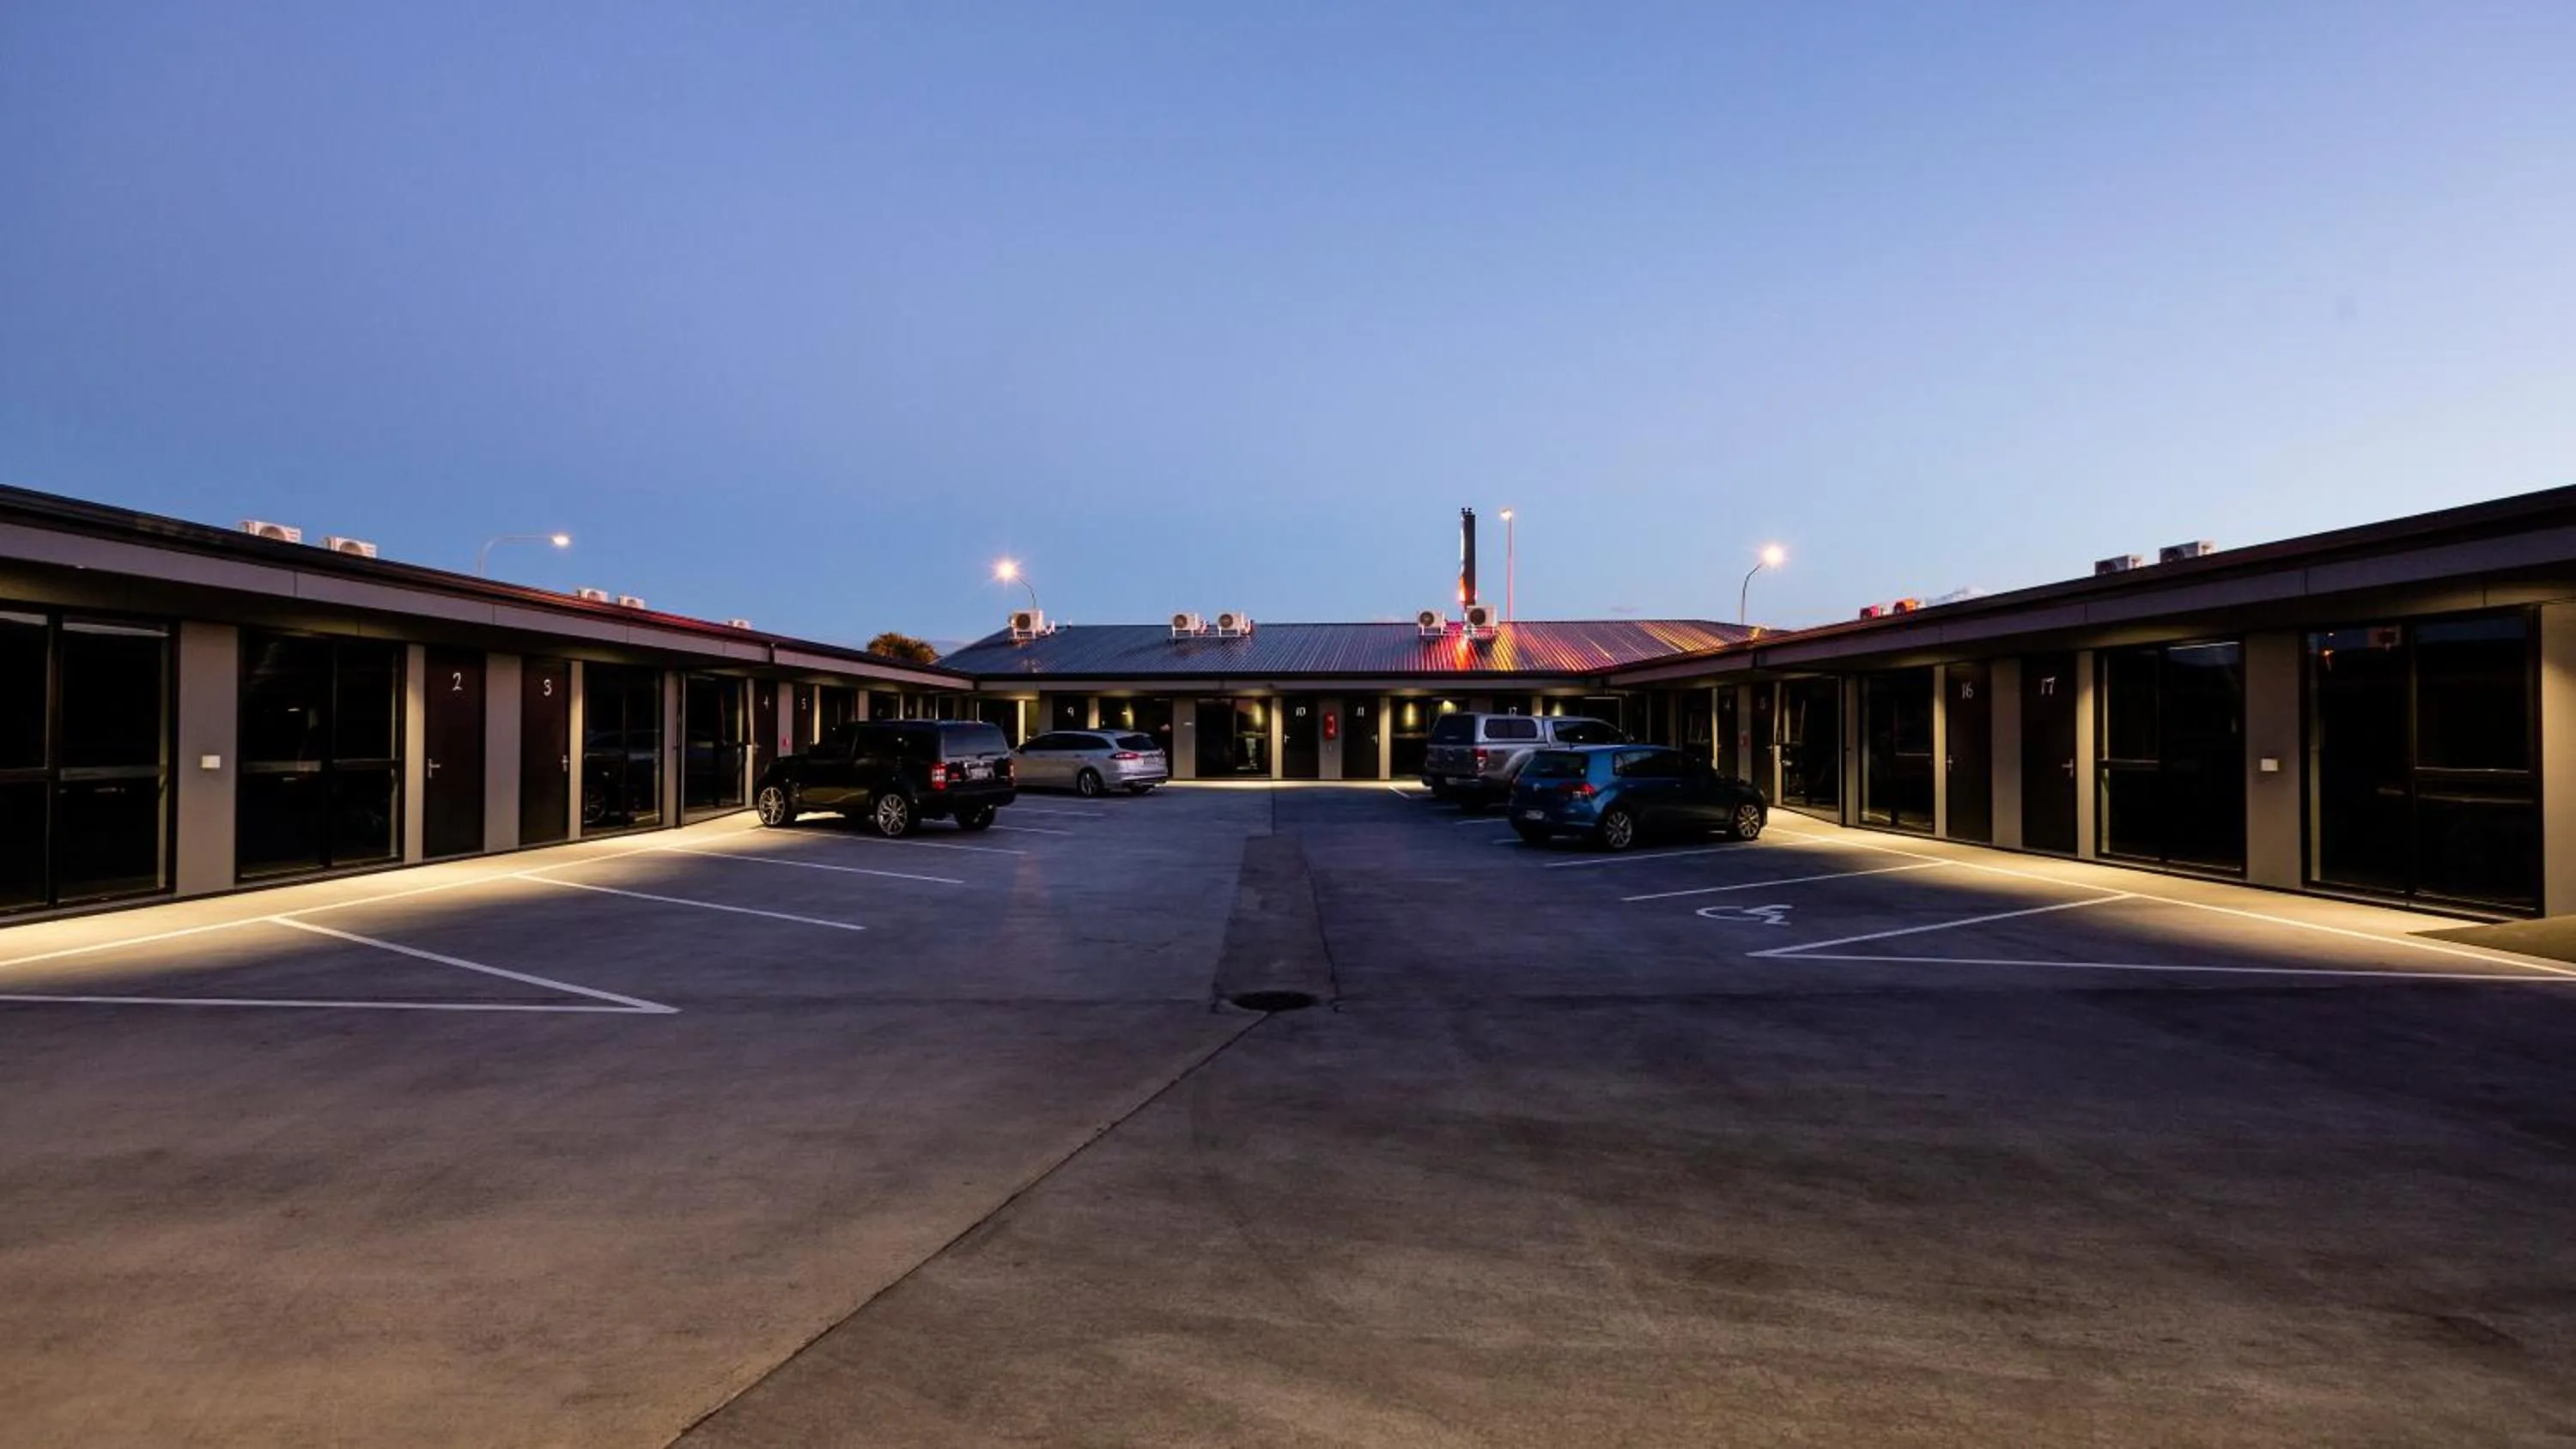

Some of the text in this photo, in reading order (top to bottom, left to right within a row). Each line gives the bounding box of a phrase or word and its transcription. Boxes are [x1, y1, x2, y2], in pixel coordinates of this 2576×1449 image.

[452, 671, 463, 692] 2
[543, 678, 553, 698] 3
[2039, 676, 2057, 696] 17
[1960, 681, 1974, 700] 16
[762, 694, 769, 710] 4
[800, 696, 808, 711] 5
[1066, 706, 1075, 718] 9
[1294, 706, 1306, 718] 10
